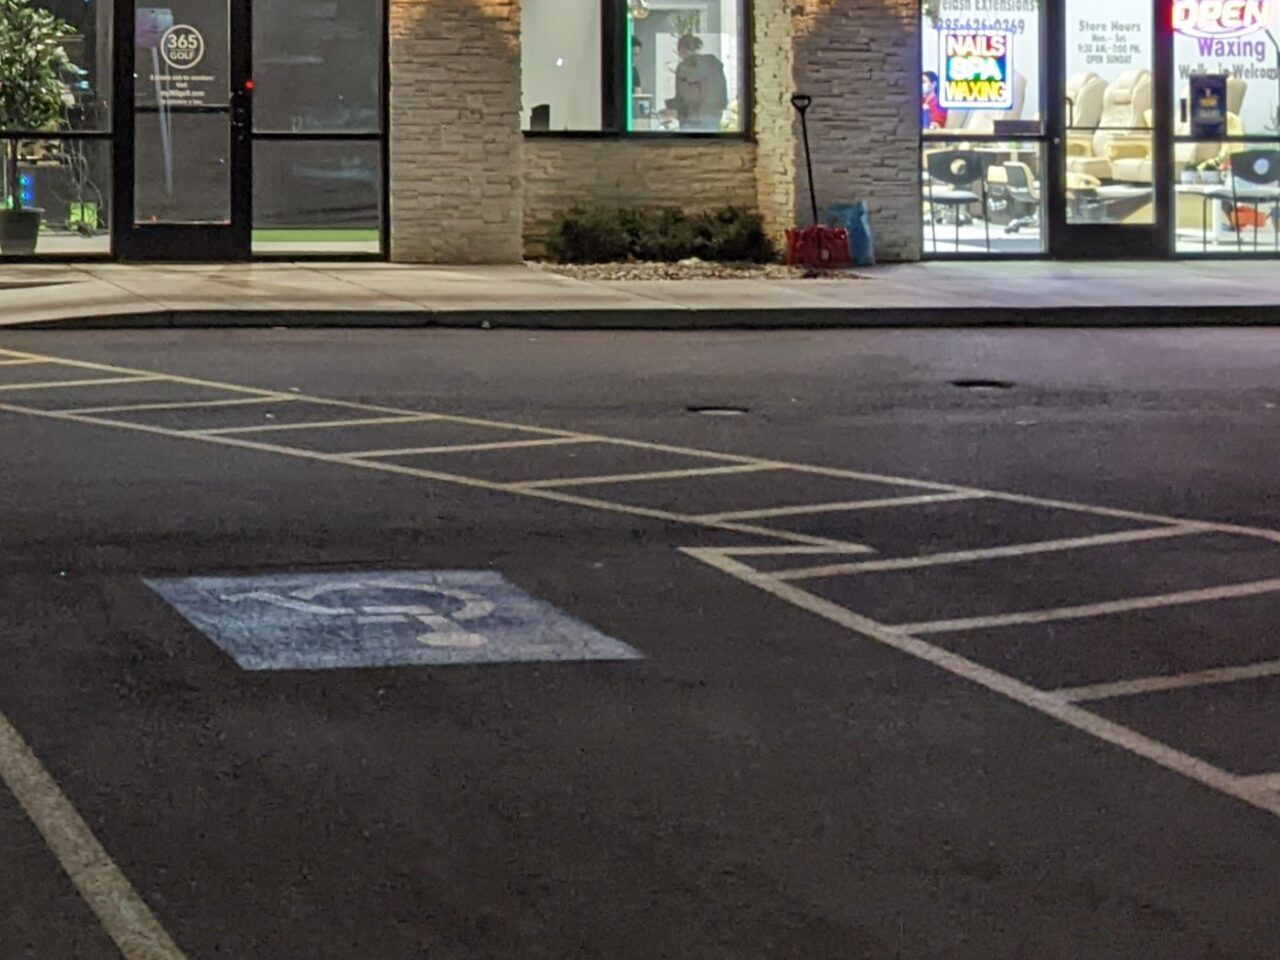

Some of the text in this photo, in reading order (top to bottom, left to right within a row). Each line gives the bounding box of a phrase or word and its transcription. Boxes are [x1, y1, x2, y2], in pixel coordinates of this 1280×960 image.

[1078, 20, 1141, 32] Store Hours
[167, 34, 198, 49] 365
[946, 34, 1006, 57] NAILS
[1198, 38, 1266, 62] Waxing
[169, 51, 195, 60] GOLF
[949, 57, 1003, 80] SPA
[945, 81, 1007, 102] WAXING
